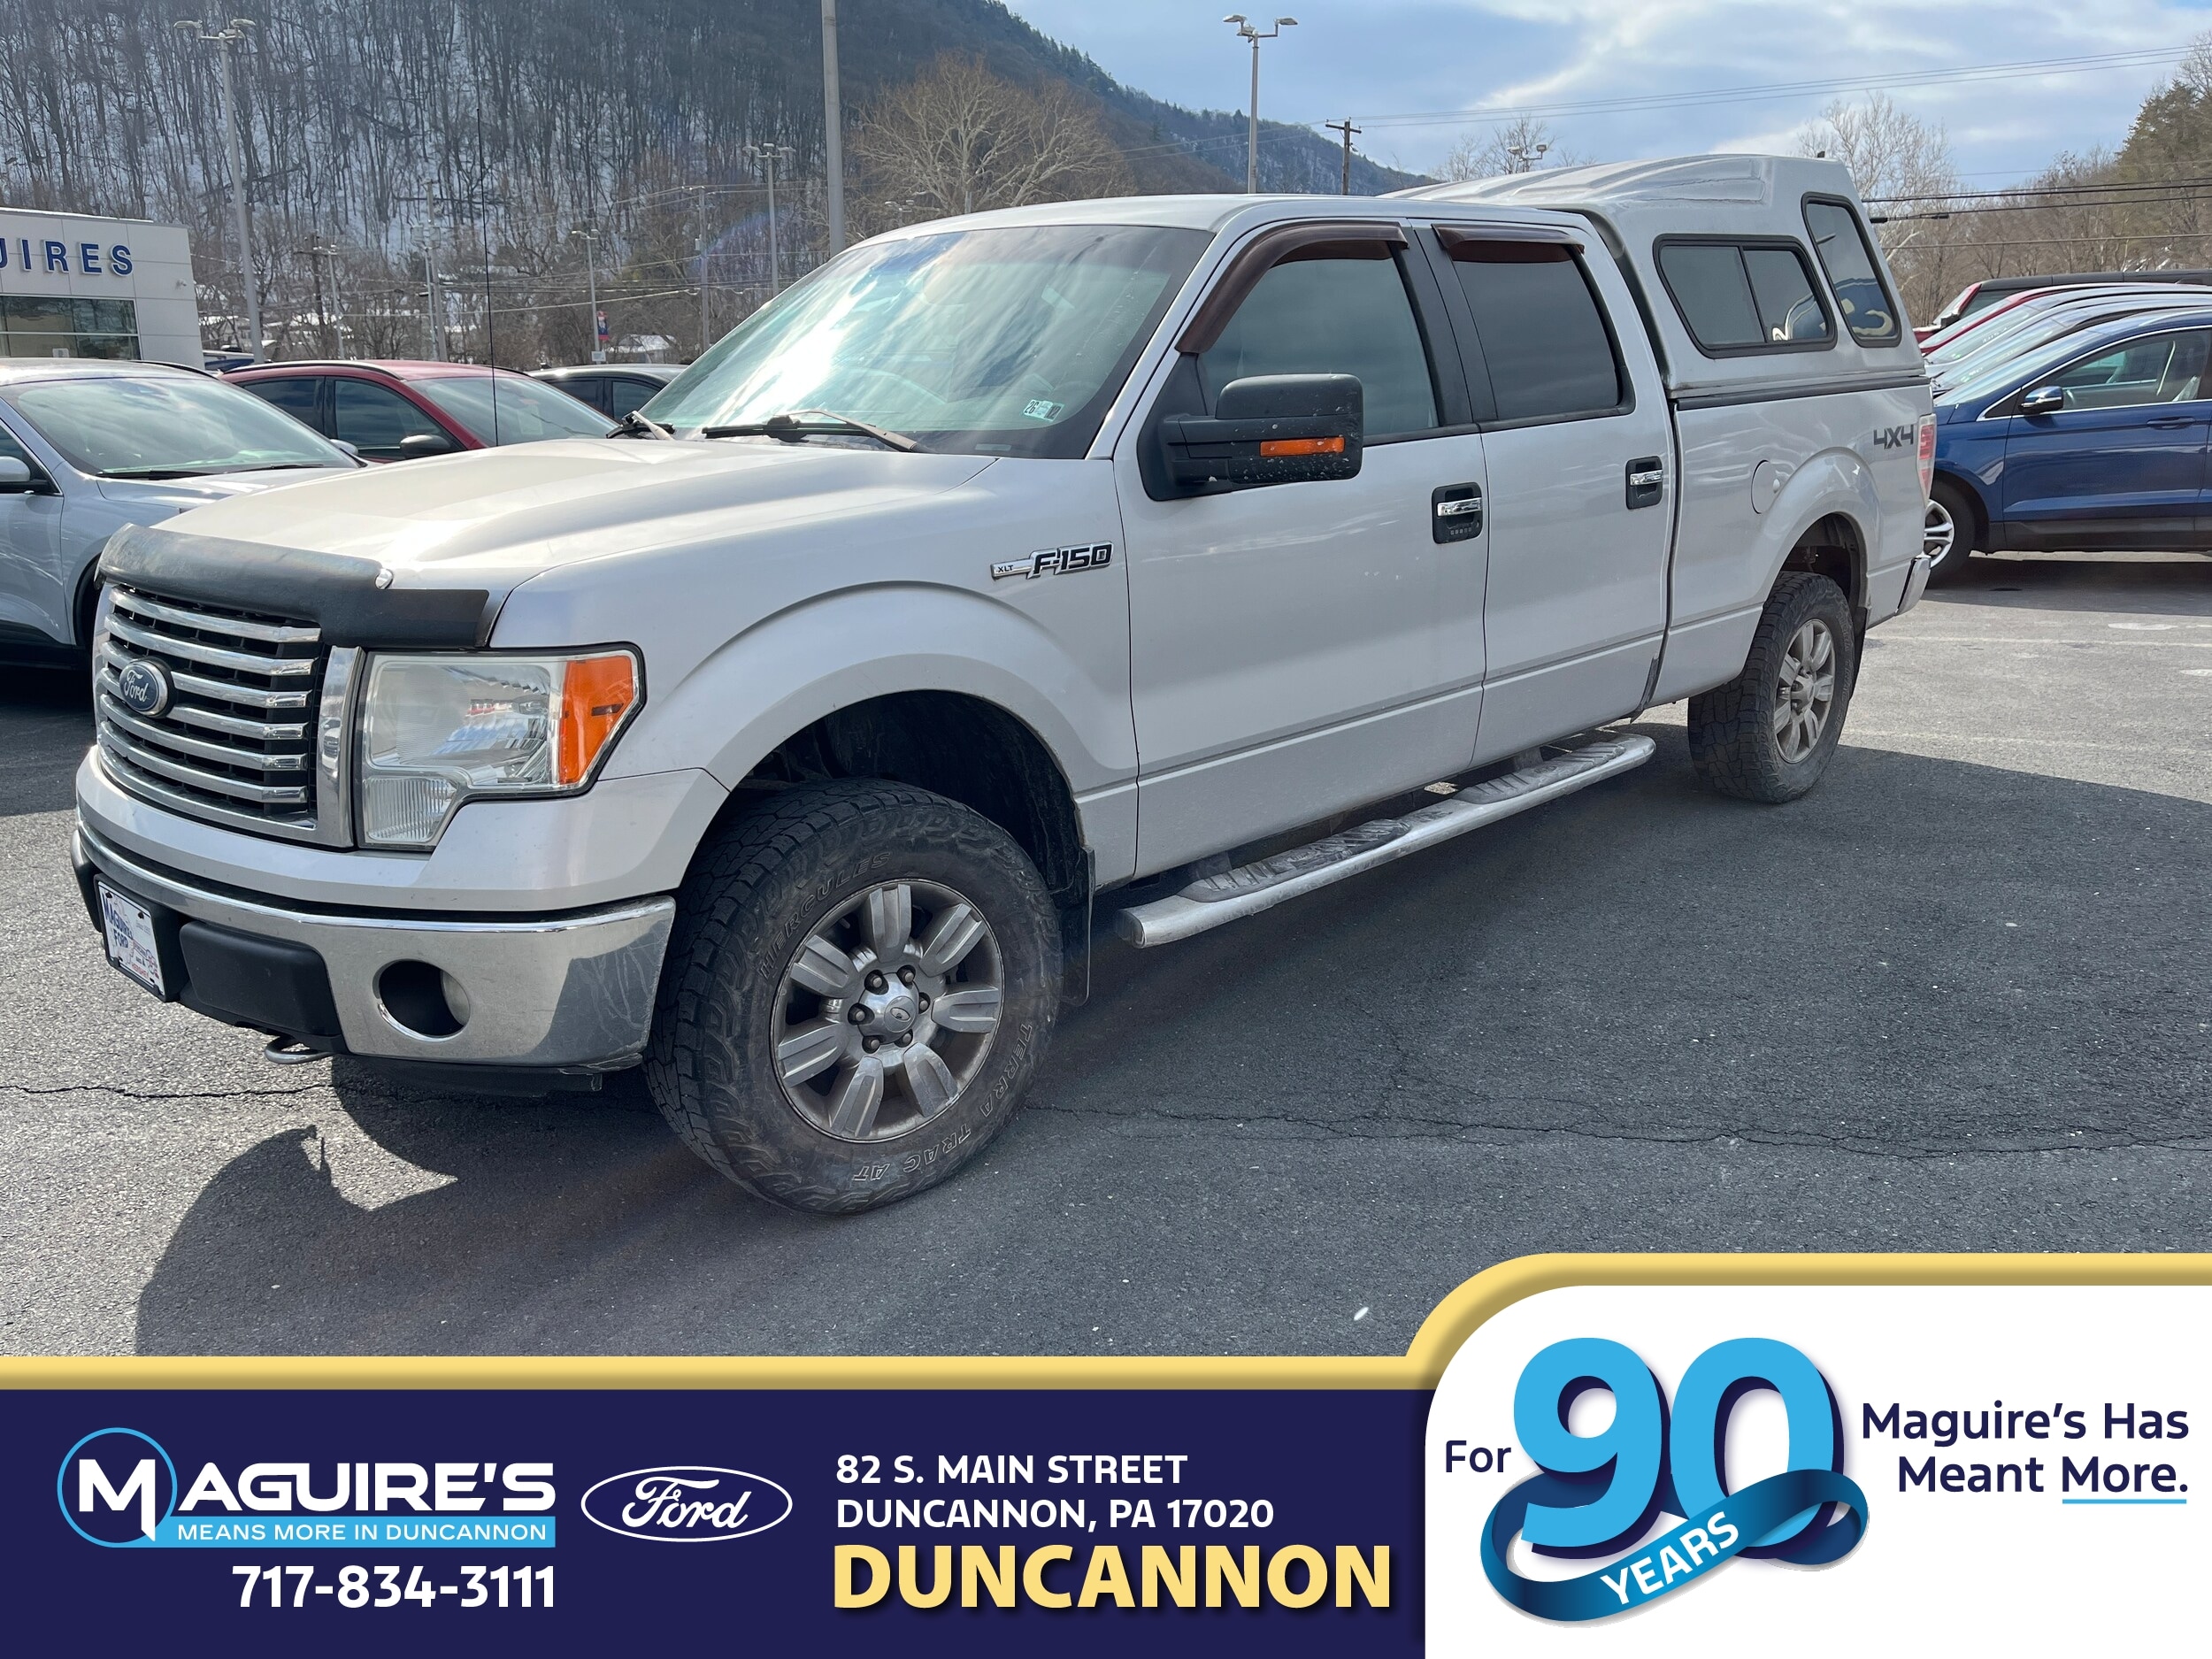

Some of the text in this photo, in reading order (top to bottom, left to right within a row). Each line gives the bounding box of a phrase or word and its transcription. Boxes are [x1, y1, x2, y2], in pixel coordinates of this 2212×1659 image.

[997, 565, 1014, 573] XLT
[1029, 541, 1113, 577] F-150
[124, 669, 149, 703] Ford
[758, 852, 891, 980] HERCULES
[852, 1023, 1033, 1181] TERRA TRAC AT
